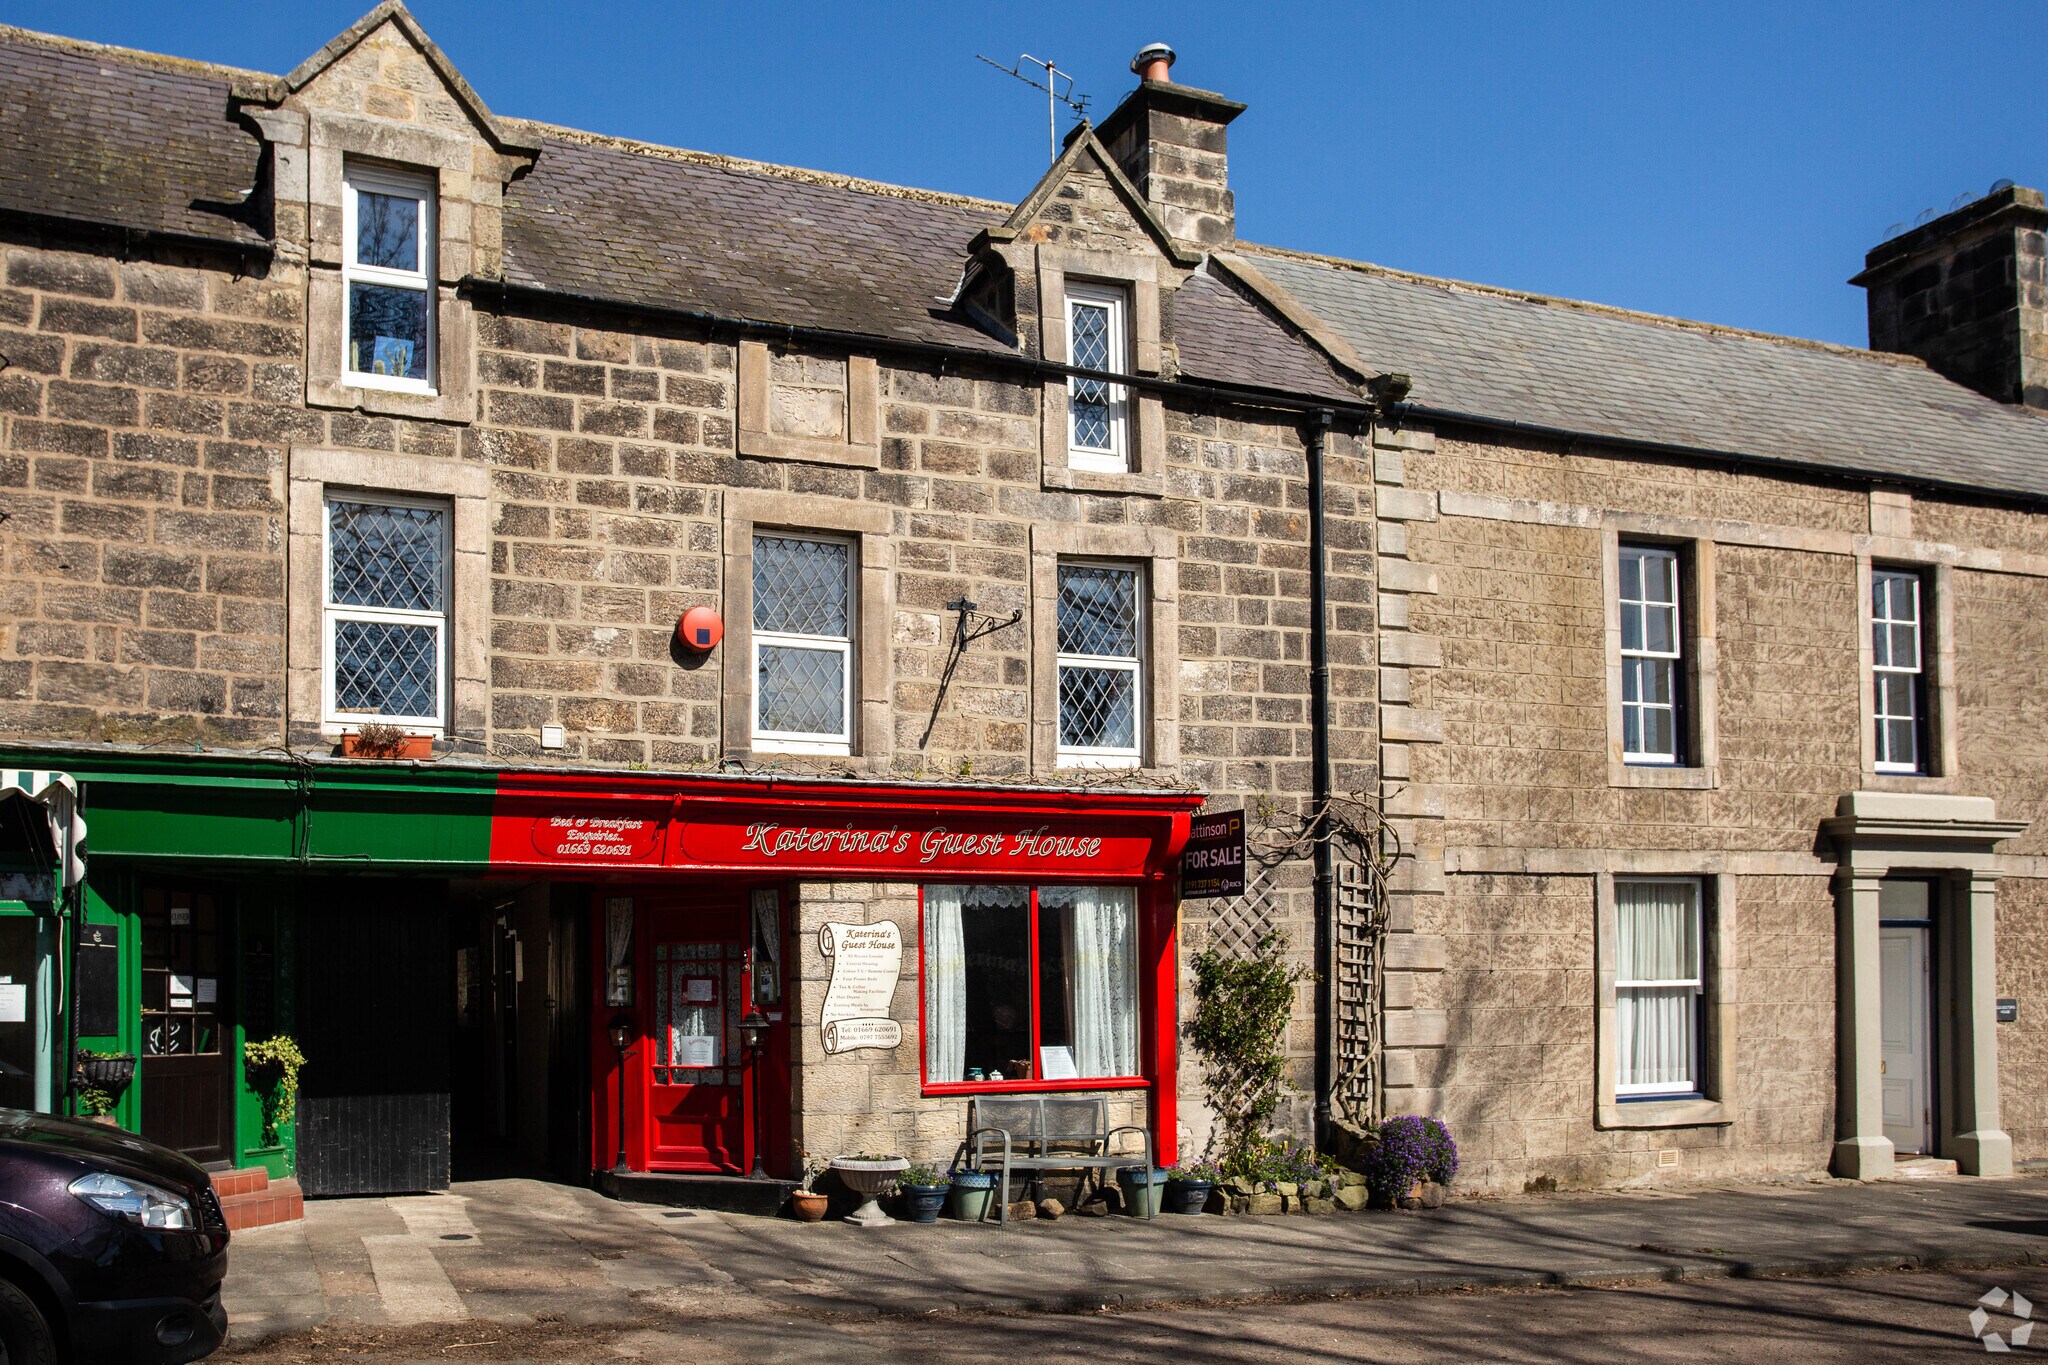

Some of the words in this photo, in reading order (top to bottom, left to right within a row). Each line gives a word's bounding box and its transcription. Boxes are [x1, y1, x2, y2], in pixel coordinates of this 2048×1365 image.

[550, 815, 575, 827] Bed
[575, 817, 588, 828] &
[589, 816, 643, 832] Breakfast
[556, 843, 592, 854] 01669
[592, 844, 632, 856] 620691
[741, 822, 912, 857] Katerina's
[919, 826, 1005, 863] Guest
[1009, 825, 1102, 857] House
[1185, 850, 1208, 870] FOR
[1210, 846, 1241, 867] SALE
[846, 929, 891, 939] Katerina's
[841, 939, 866, 951] Guest
[868, 939, 896, 949] House
